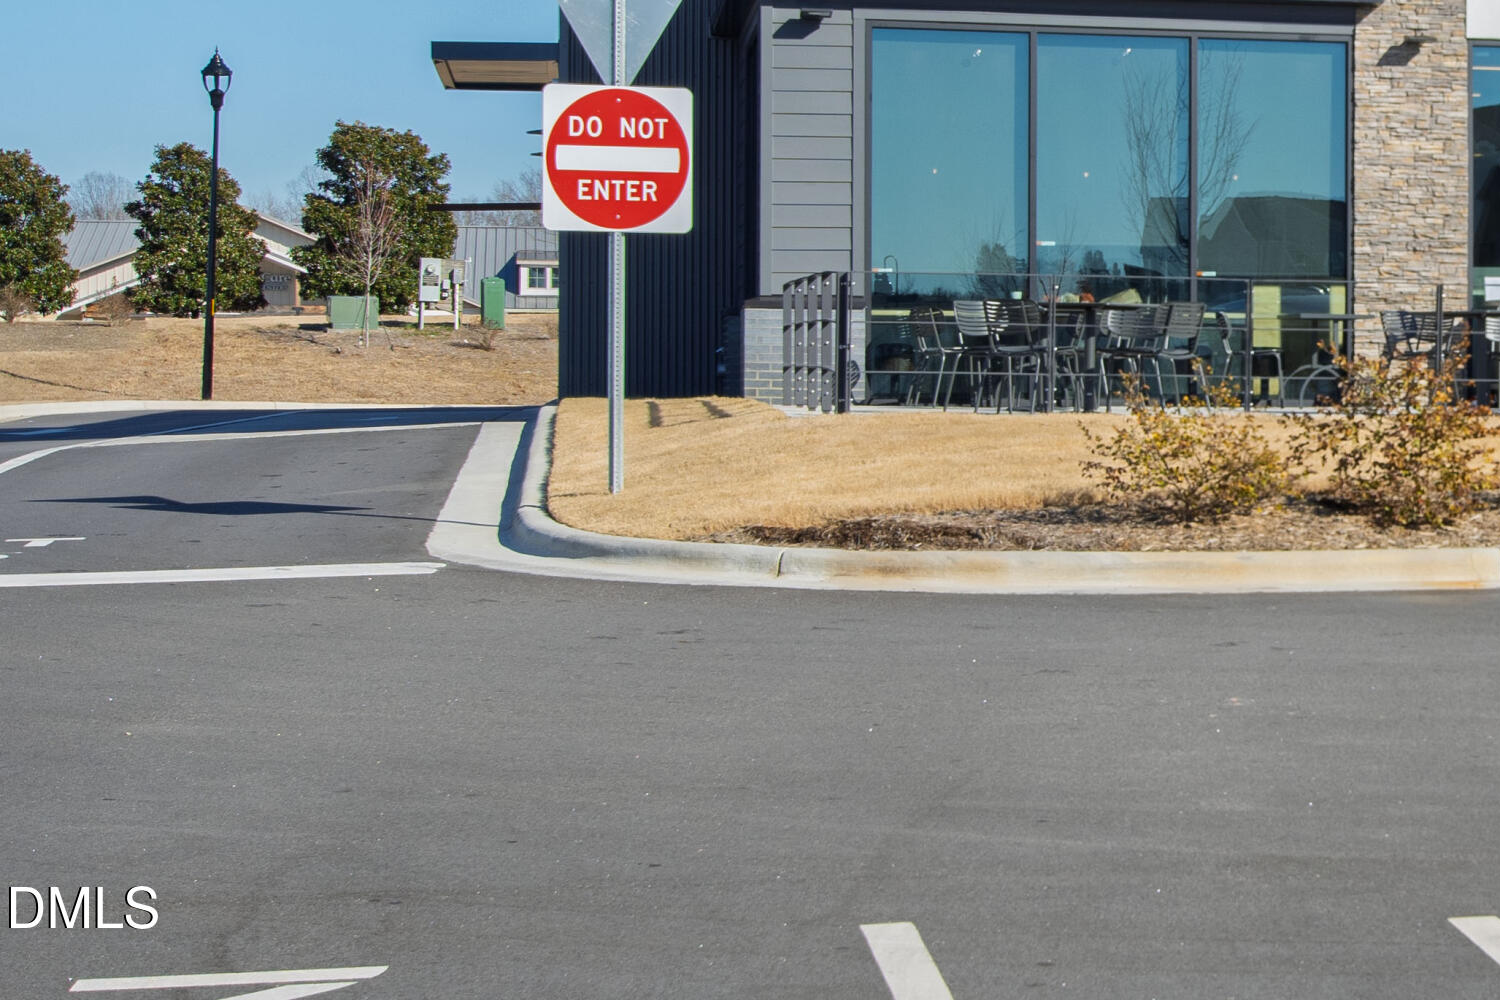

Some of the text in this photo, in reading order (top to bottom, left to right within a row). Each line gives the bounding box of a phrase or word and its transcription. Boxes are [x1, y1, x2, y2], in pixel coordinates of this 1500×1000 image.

[568, 115, 669, 140] DO NOT
[577, 179, 658, 202] ENTER
